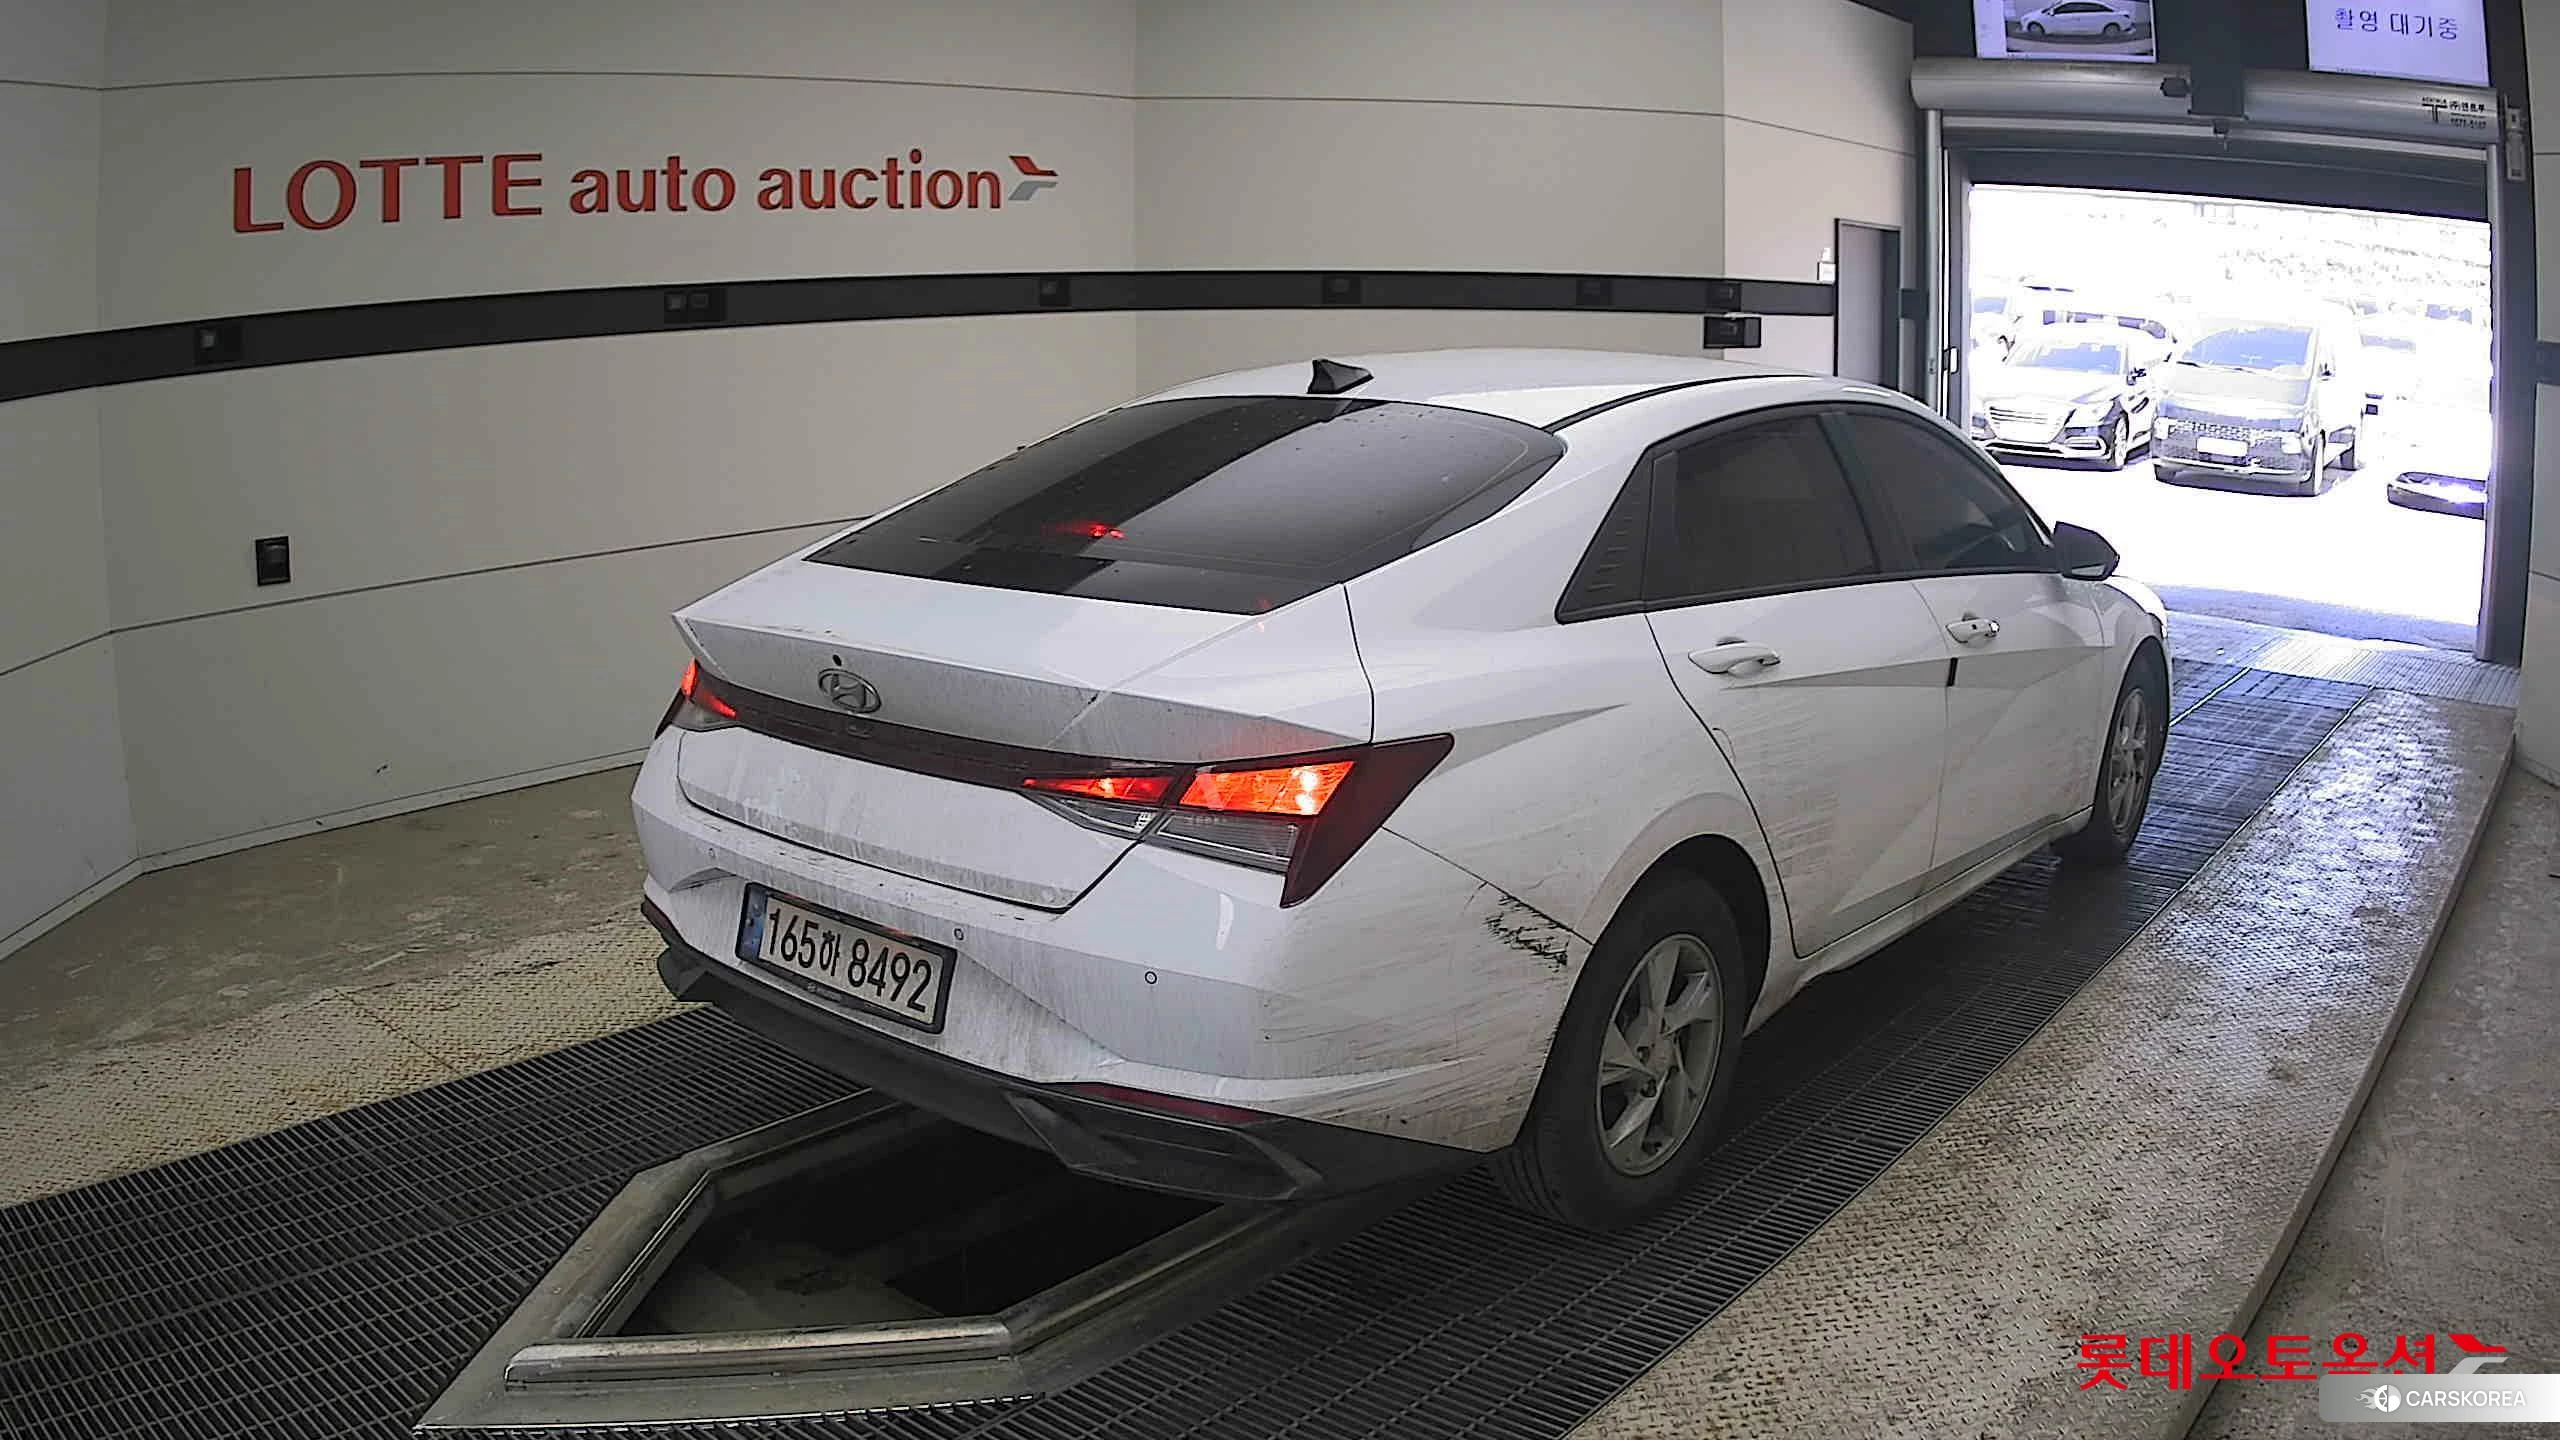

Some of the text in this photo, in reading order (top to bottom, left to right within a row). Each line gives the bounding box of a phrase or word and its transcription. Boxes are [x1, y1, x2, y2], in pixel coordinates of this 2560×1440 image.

[2335, 7, 2379, 33] 촬영
[233, 148, 1003, 232] LOTTE auto auction
[769, 908, 933, 1014] 165하 8492
